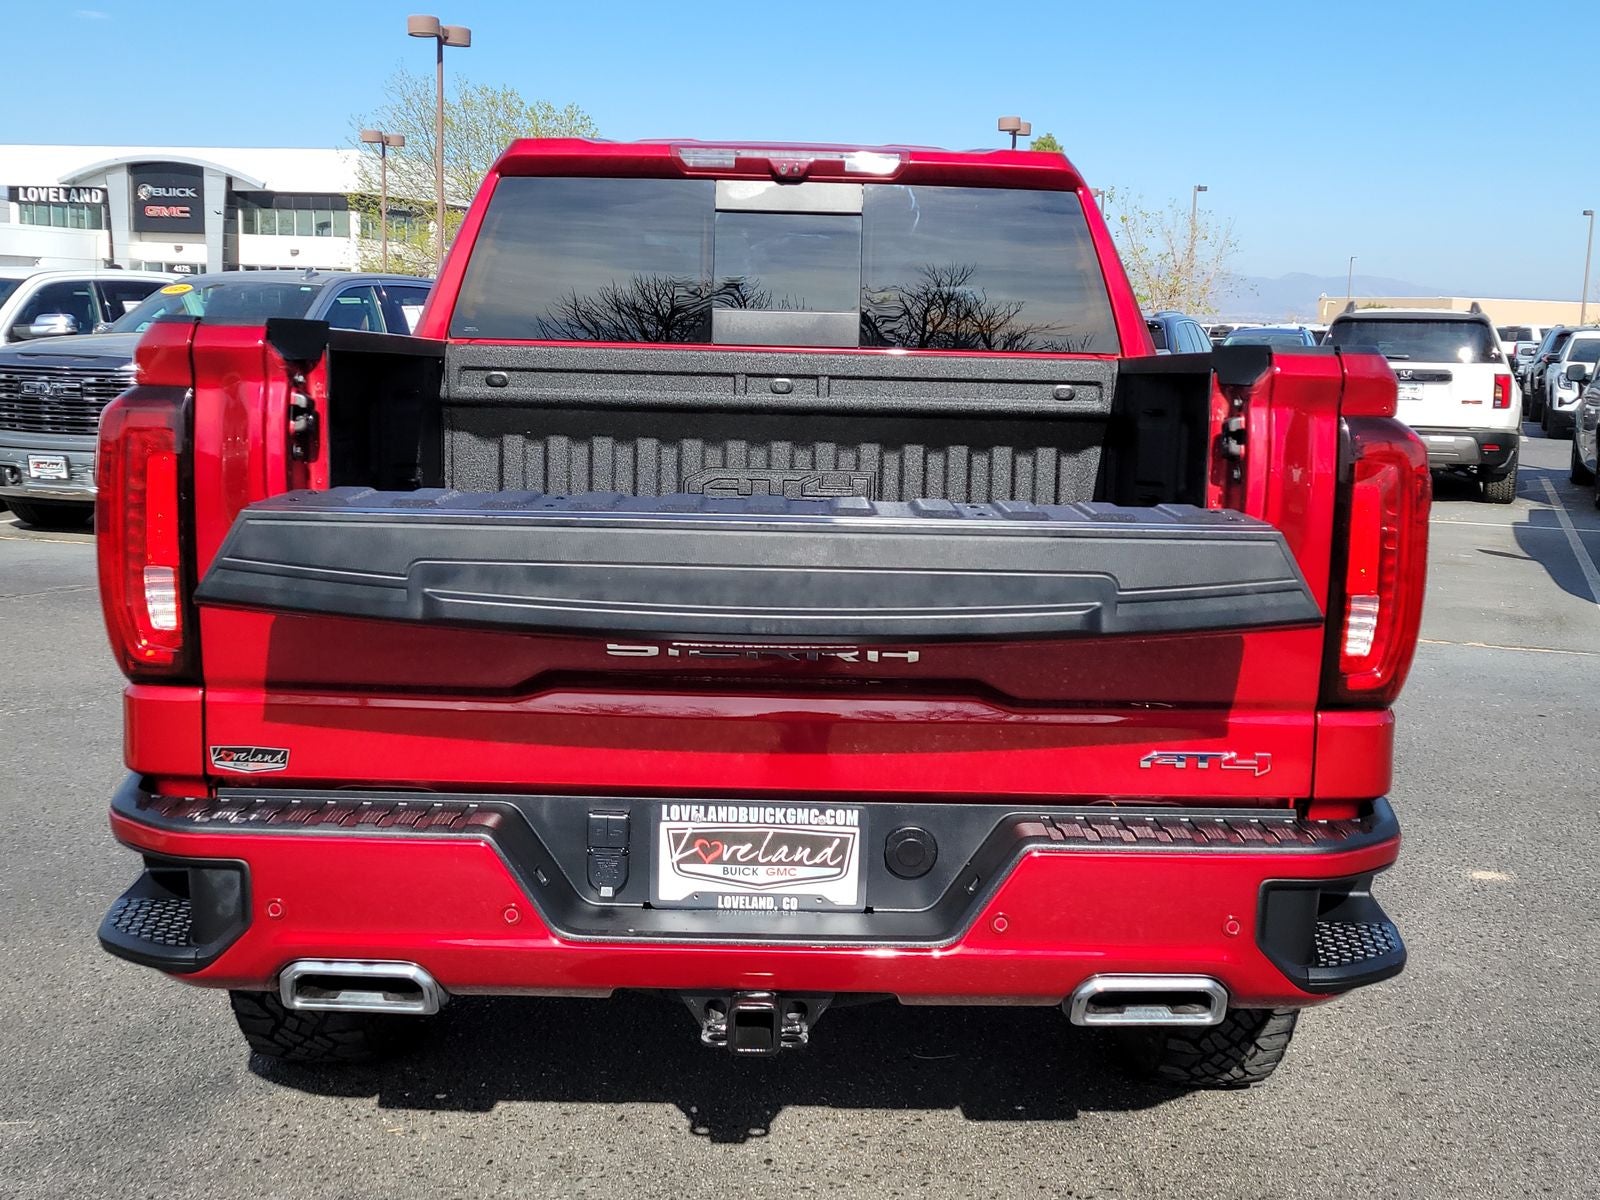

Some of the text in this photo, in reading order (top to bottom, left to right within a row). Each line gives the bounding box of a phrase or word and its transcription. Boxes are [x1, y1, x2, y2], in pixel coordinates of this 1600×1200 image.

[18, 187, 103, 203] LOVELAND
[152, 187, 198, 197] BUICK
[144, 205, 191, 218] GMC
[1139, 750, 1272, 777] AT4
[722, 866, 798, 877] BUICK GMC
[717, 895, 799, 911] LOVELAND, CO
